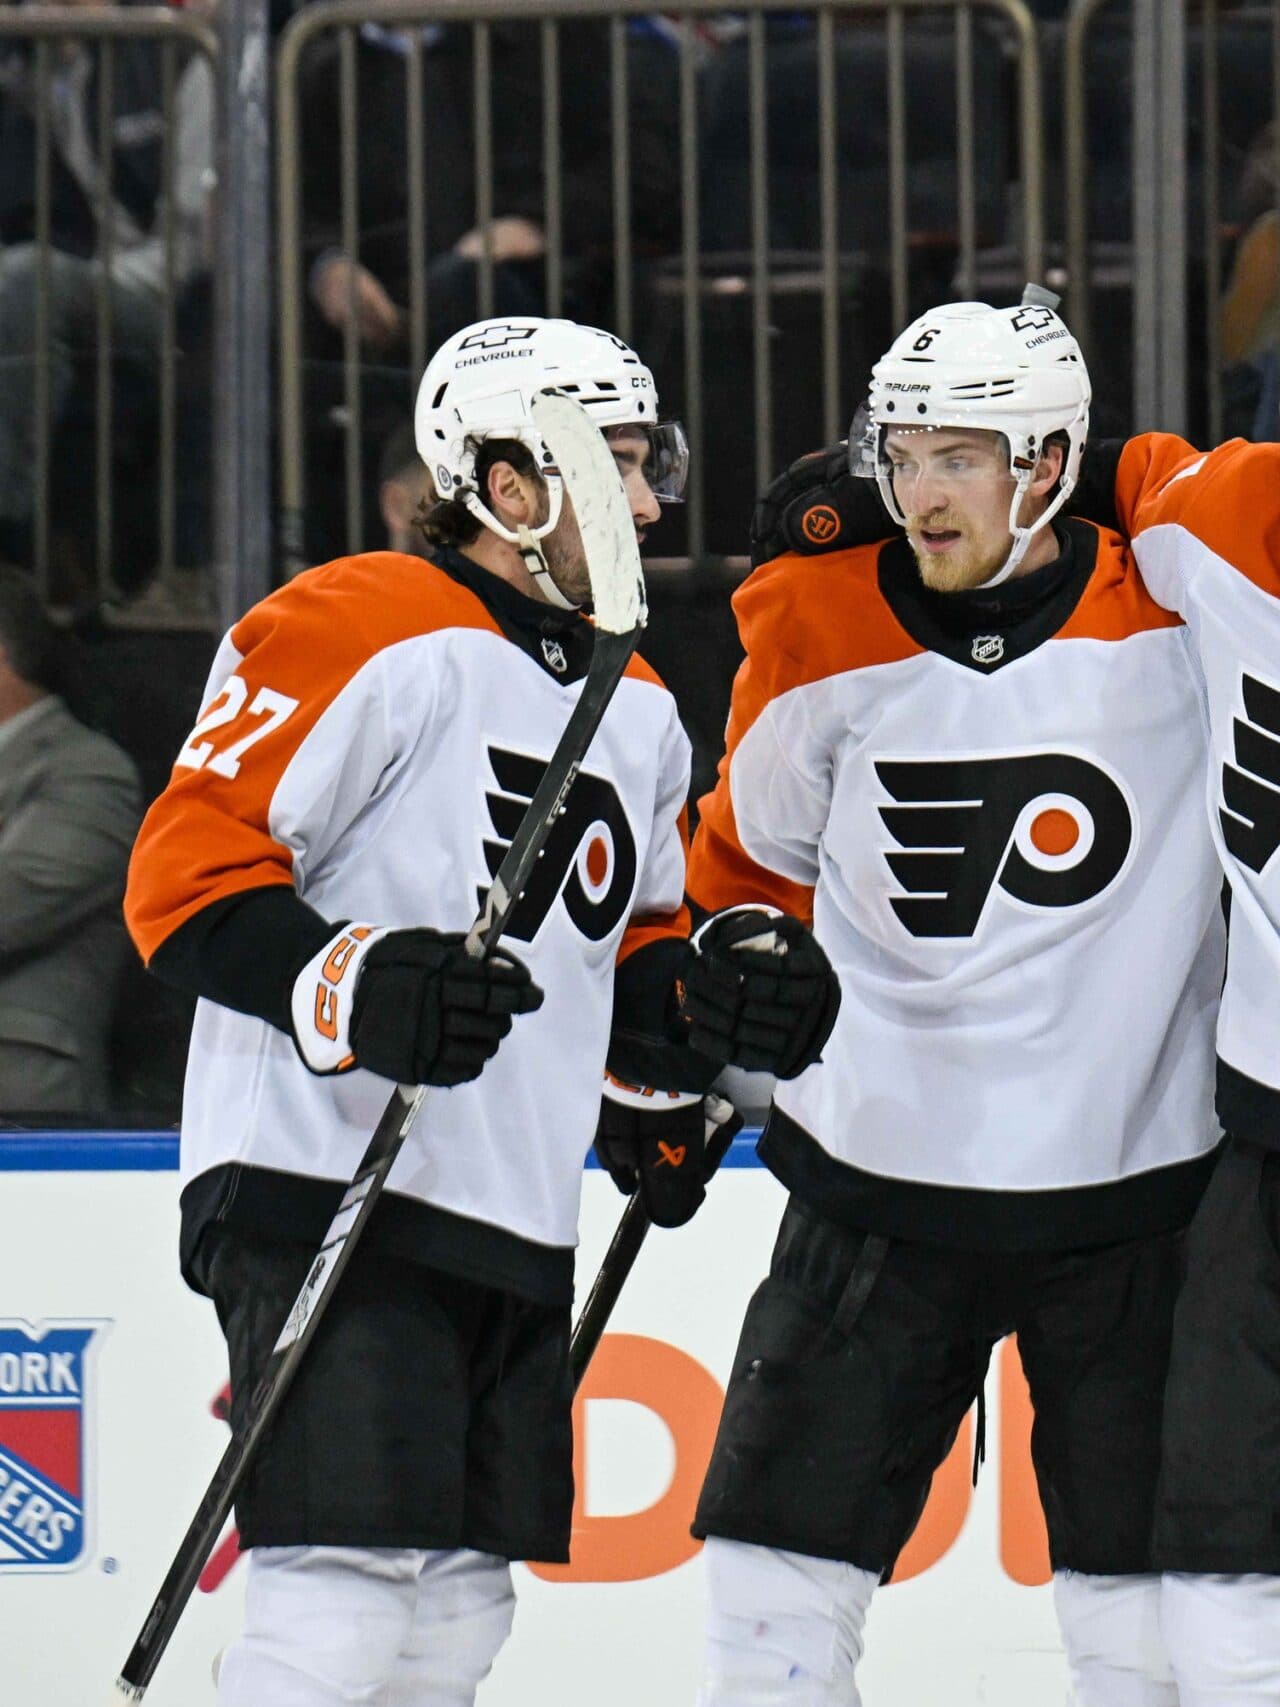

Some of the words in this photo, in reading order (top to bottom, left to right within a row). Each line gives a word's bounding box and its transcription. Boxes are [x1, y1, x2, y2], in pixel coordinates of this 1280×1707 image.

[912, 328, 941, 352] 6
[454, 349, 536, 370] CHEVROLET
[630, 377, 652, 389] CC
[175, 674, 300, 780] 27
[314, 926, 373, 1042] CC
